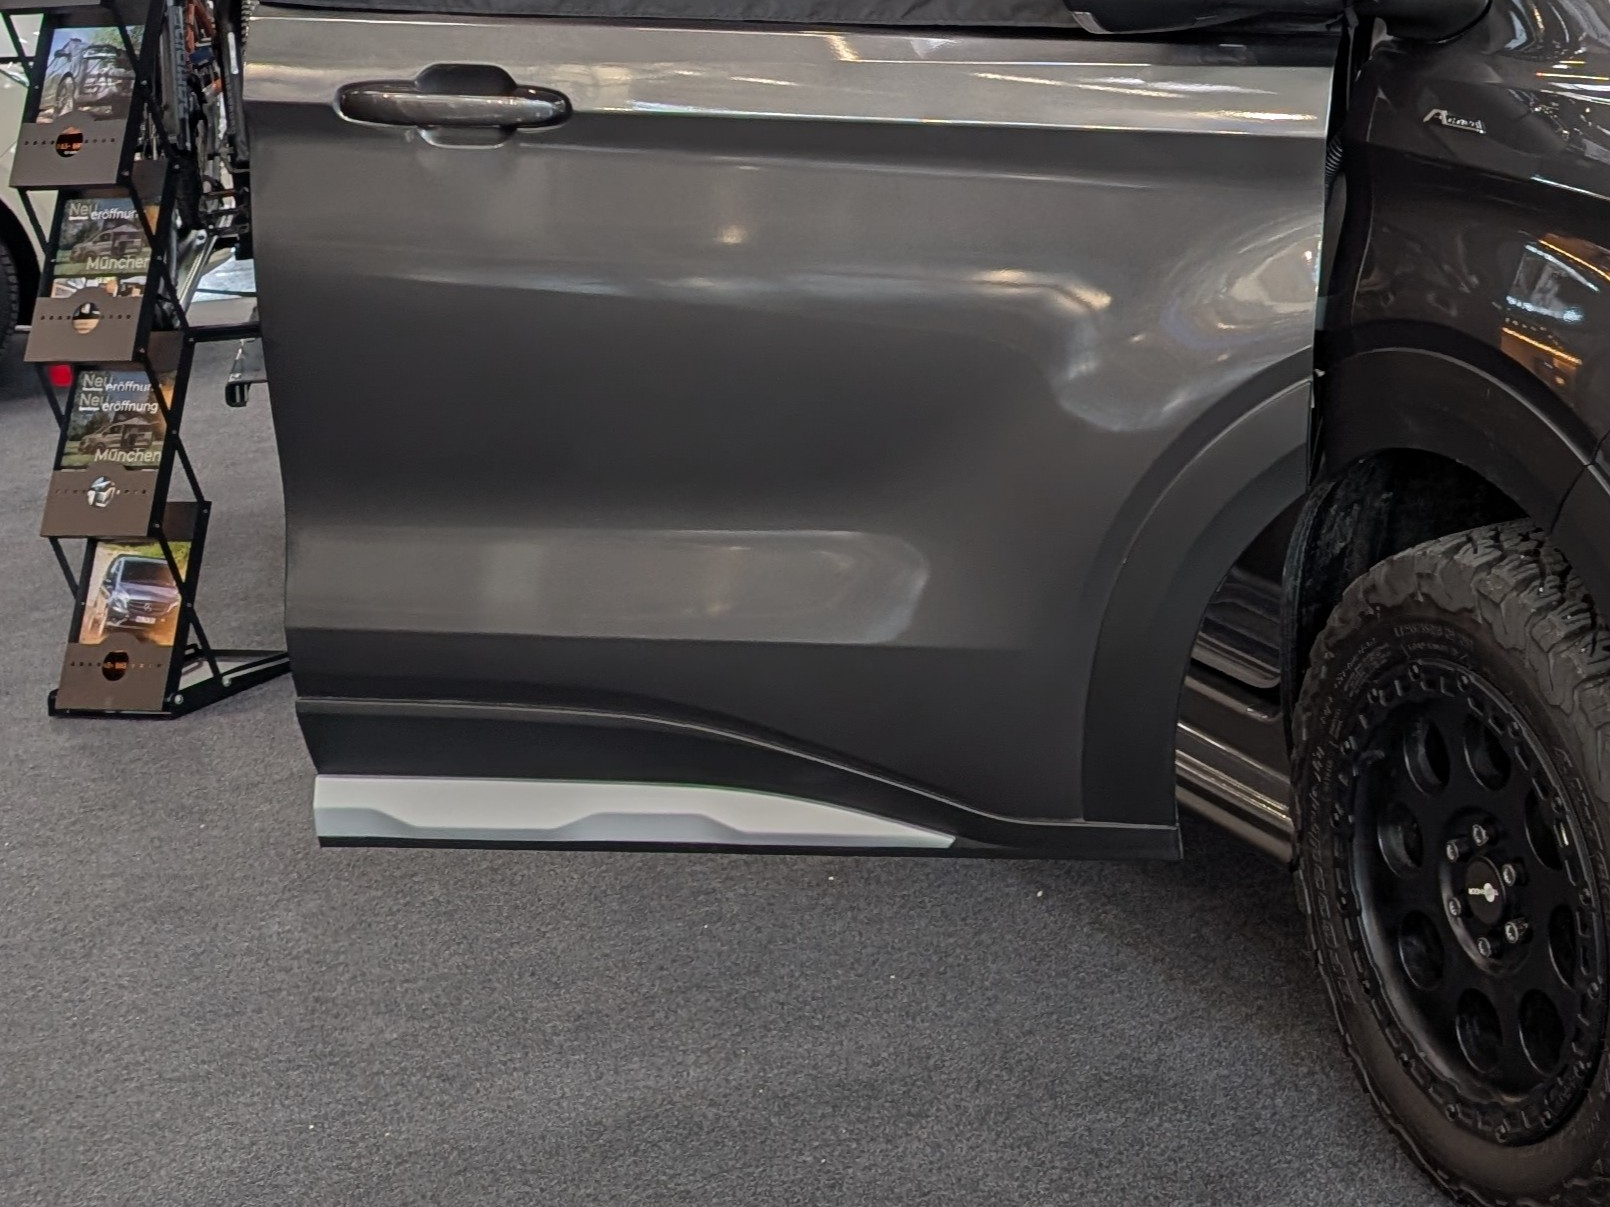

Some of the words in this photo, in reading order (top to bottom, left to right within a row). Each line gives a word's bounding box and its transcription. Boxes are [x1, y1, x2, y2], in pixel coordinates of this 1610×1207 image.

[69, 202, 98, 217] Neu
[82, 373, 113, 388] Neu
[79, 392, 110, 407] Neu
[101, 400, 158, 414] eröffnung
[94, 447, 161, 463] München
